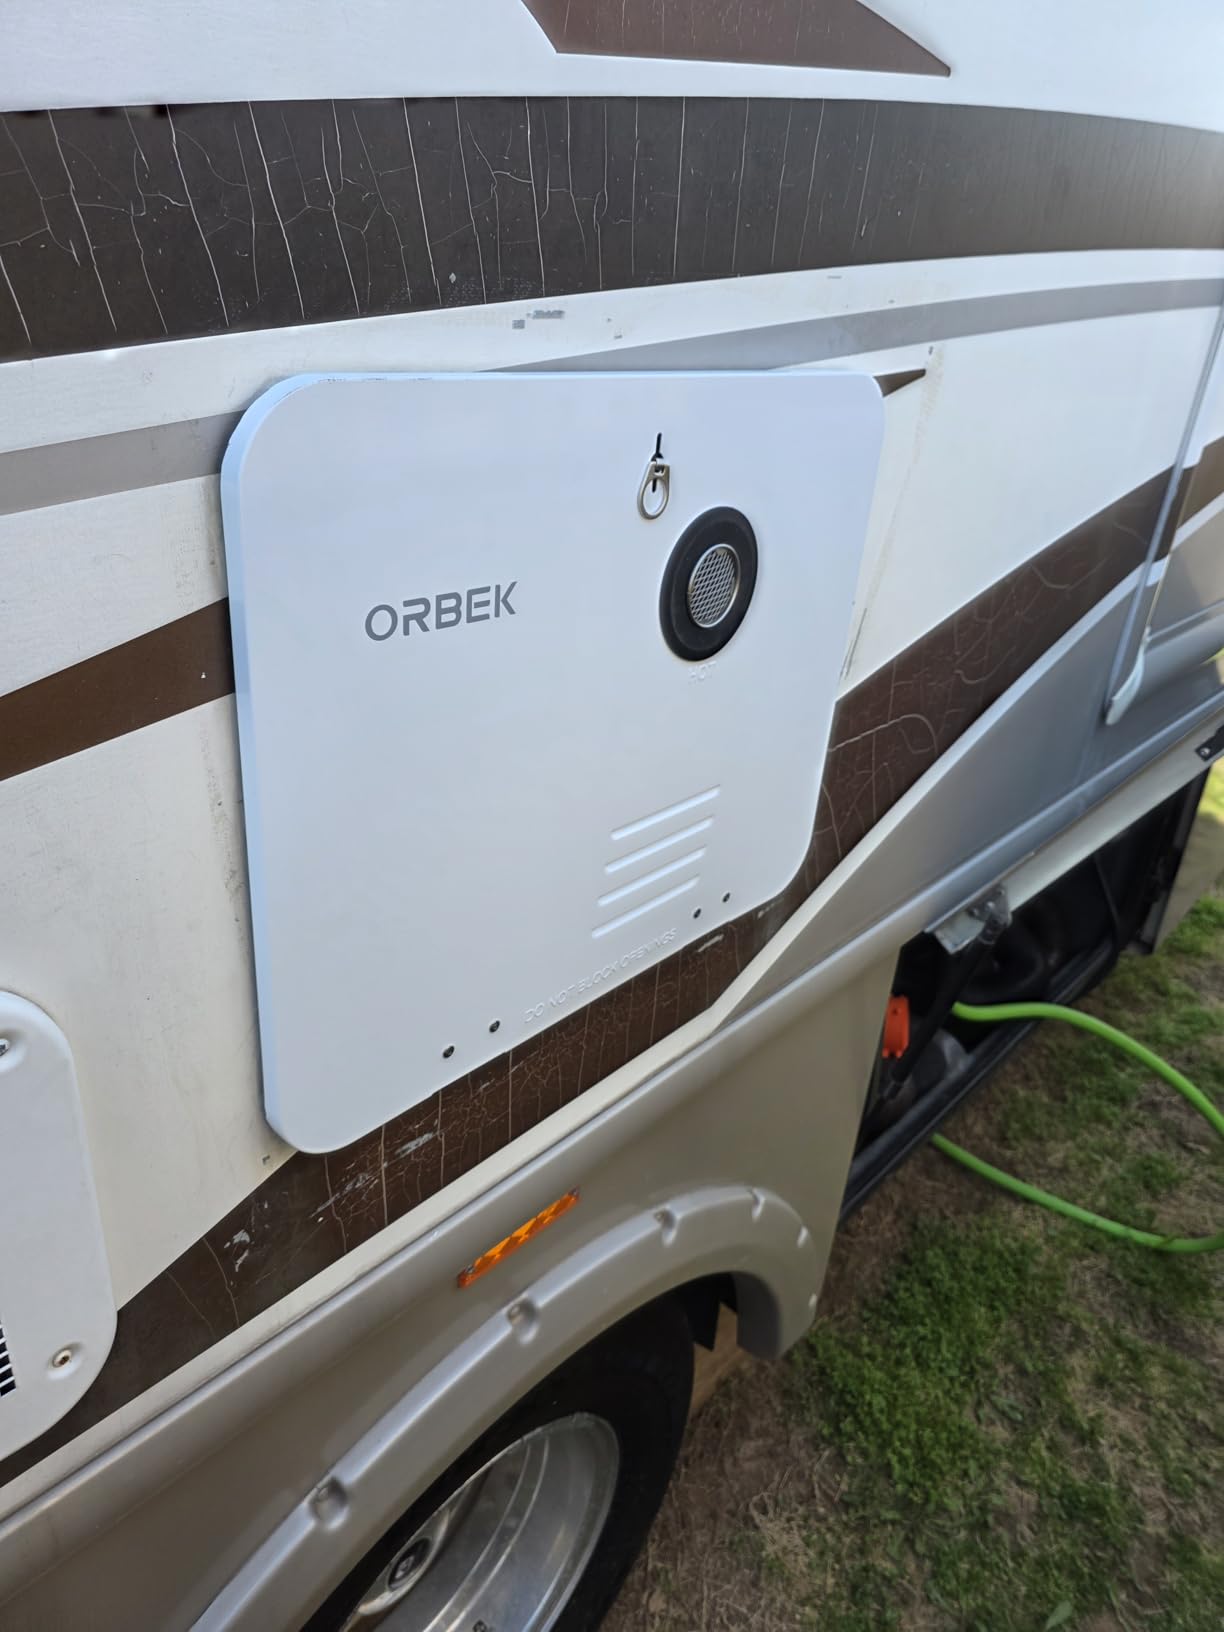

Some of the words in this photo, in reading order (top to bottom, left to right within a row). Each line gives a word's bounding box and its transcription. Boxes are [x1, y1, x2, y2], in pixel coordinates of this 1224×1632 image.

[365, 581, 518, 641] ORBEK
[523, 1002, 545, 1023] DO
[550, 984, 576, 1008] NOT
[577, 960, 619, 994] BLOCK
[619, 927, 678, 968] OPENNGS
